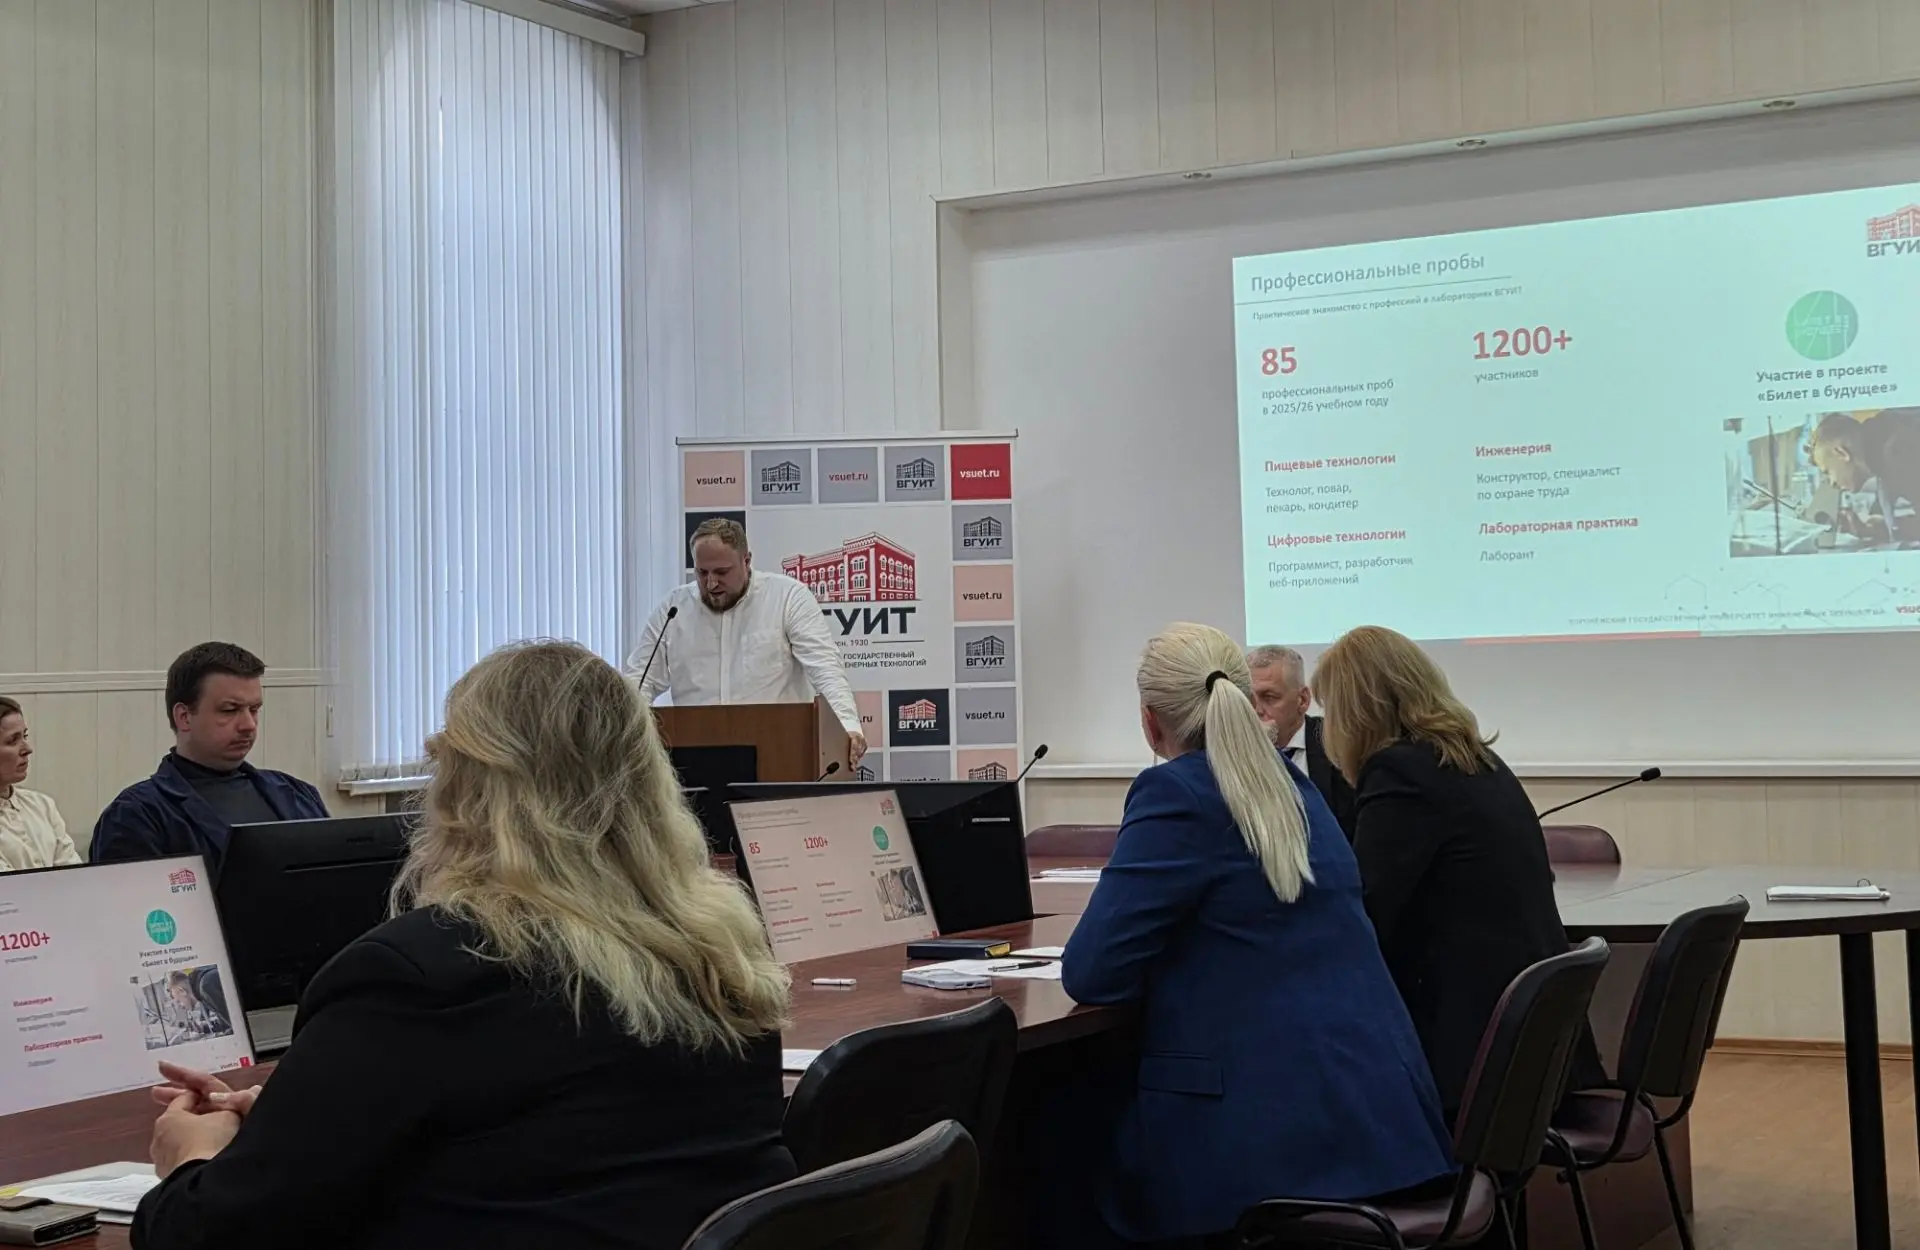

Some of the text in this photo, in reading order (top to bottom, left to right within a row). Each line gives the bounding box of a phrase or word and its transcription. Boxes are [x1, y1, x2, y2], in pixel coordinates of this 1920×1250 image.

[1252, 253, 1484, 293] Профессиональные пробы
[1253, 308, 1310, 321] Практическое
[1312, 302, 1360, 314] знакомство
[1494, 286, 1522, 297] ВГУИТ
[1473, 325, 1573, 360] 1200+
[1261, 346, 1298, 375] 85
[1474, 368, 1539, 383] участников
[1757, 363, 1889, 383] Участие в проекте
[1262, 378, 1394, 400] профессиональных проб
[1757, 383, 1898, 402] «Билет в будущее»
[1263, 397, 1389, 416] в 2025/26 учебном году
[1475, 443, 1552, 457] Инженерия
[1265, 454, 1396, 473] Пищевые технологии
[696, 475, 736, 486] vsuet.ru
[828, 472, 869, 482] vsuet.ru
[959, 469, 1000, 478] vsuet.ru
[1477, 466, 1622, 485] Конструктор, специалист
[761, 482, 801, 493] ВГУИТ
[896, 479, 935, 489] ВГУИТ
[1266, 483, 1352, 498] Технолог, повар,
[1477, 486, 1570, 501] по охране труда
[1266, 499, 1360, 514] пекарь, кондитер
[1479, 516, 1639, 536] Лабораторная практика
[963, 537, 1003, 547] ВГУИТ
[1267, 529, 1406, 548] Цифровые технологии
[1269, 555, 1414, 573] Программист, разработчик
[1479, 550, 1535, 563] Лаборант
[1269, 573, 1359, 588] веб-приложений
[962, 591, 1003, 601] vsuet.ru
[850, 638, 869, 647] 1930
[843, 650, 915, 661] ГОСУДАРСТВЕННЫЙ
[880, 658, 927, 668] ТЕХНОЛОГИЙ
[965, 656, 1005, 667] ВГУИТ
[965, 711, 1005, 720] vsuet.ru
[898, 719, 937, 730] ВГУИТ
[748, 841, 761, 855] 85
[803, 836, 829, 850] 1200+
[171, 883, 197, 894] ВГУИТ
[0, 930, 51, 951] 1200+
